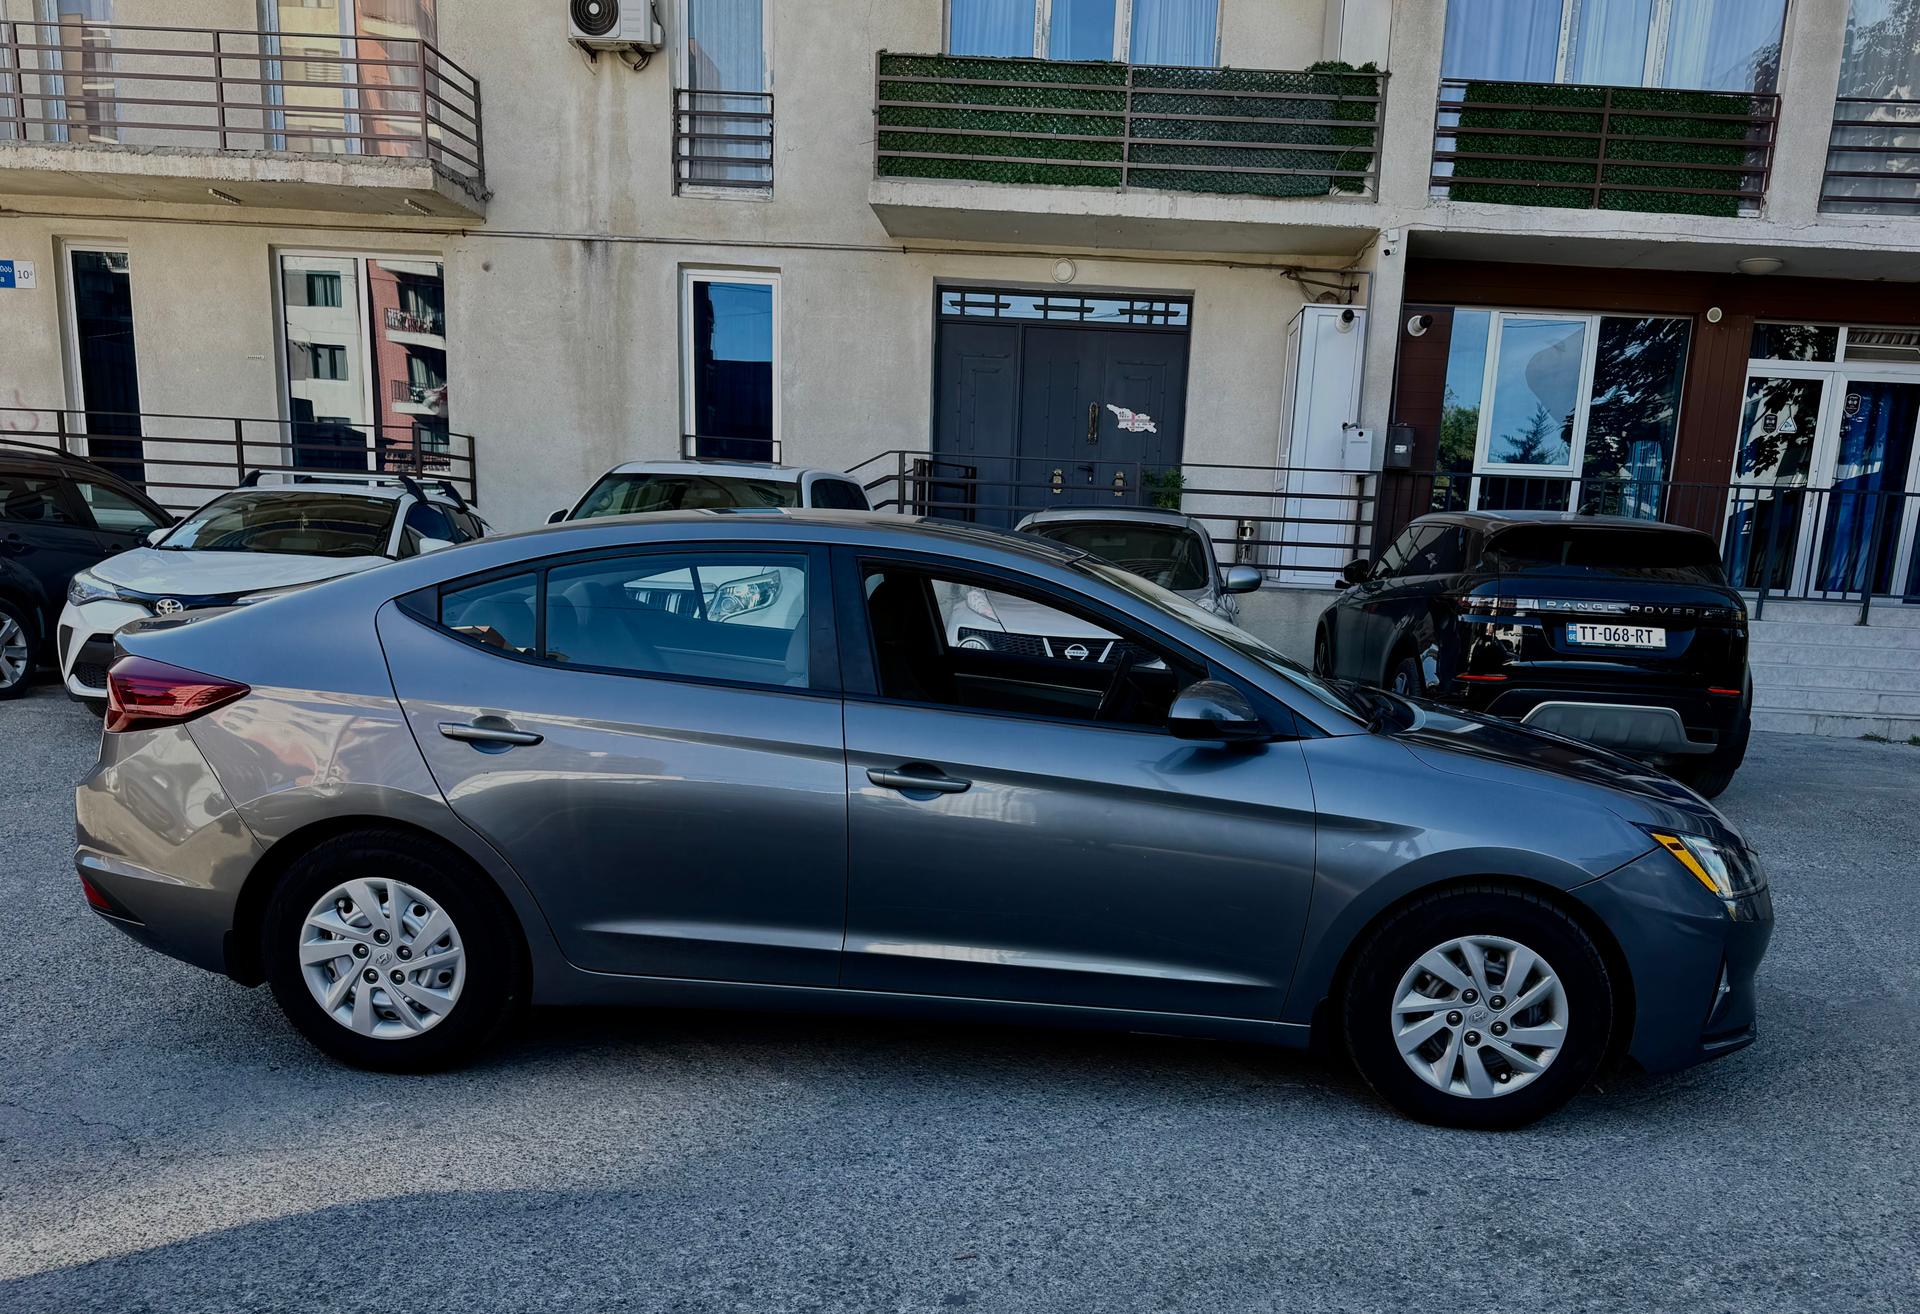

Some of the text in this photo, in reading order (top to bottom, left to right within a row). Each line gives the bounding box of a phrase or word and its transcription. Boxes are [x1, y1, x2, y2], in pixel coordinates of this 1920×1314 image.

[1546, 601, 1617, 610] RANGE
[1630, 605, 1695, 616] ROVER
[1568, 633, 1576, 641] GE
[1580, 626, 1654, 644] TT-068-RT
